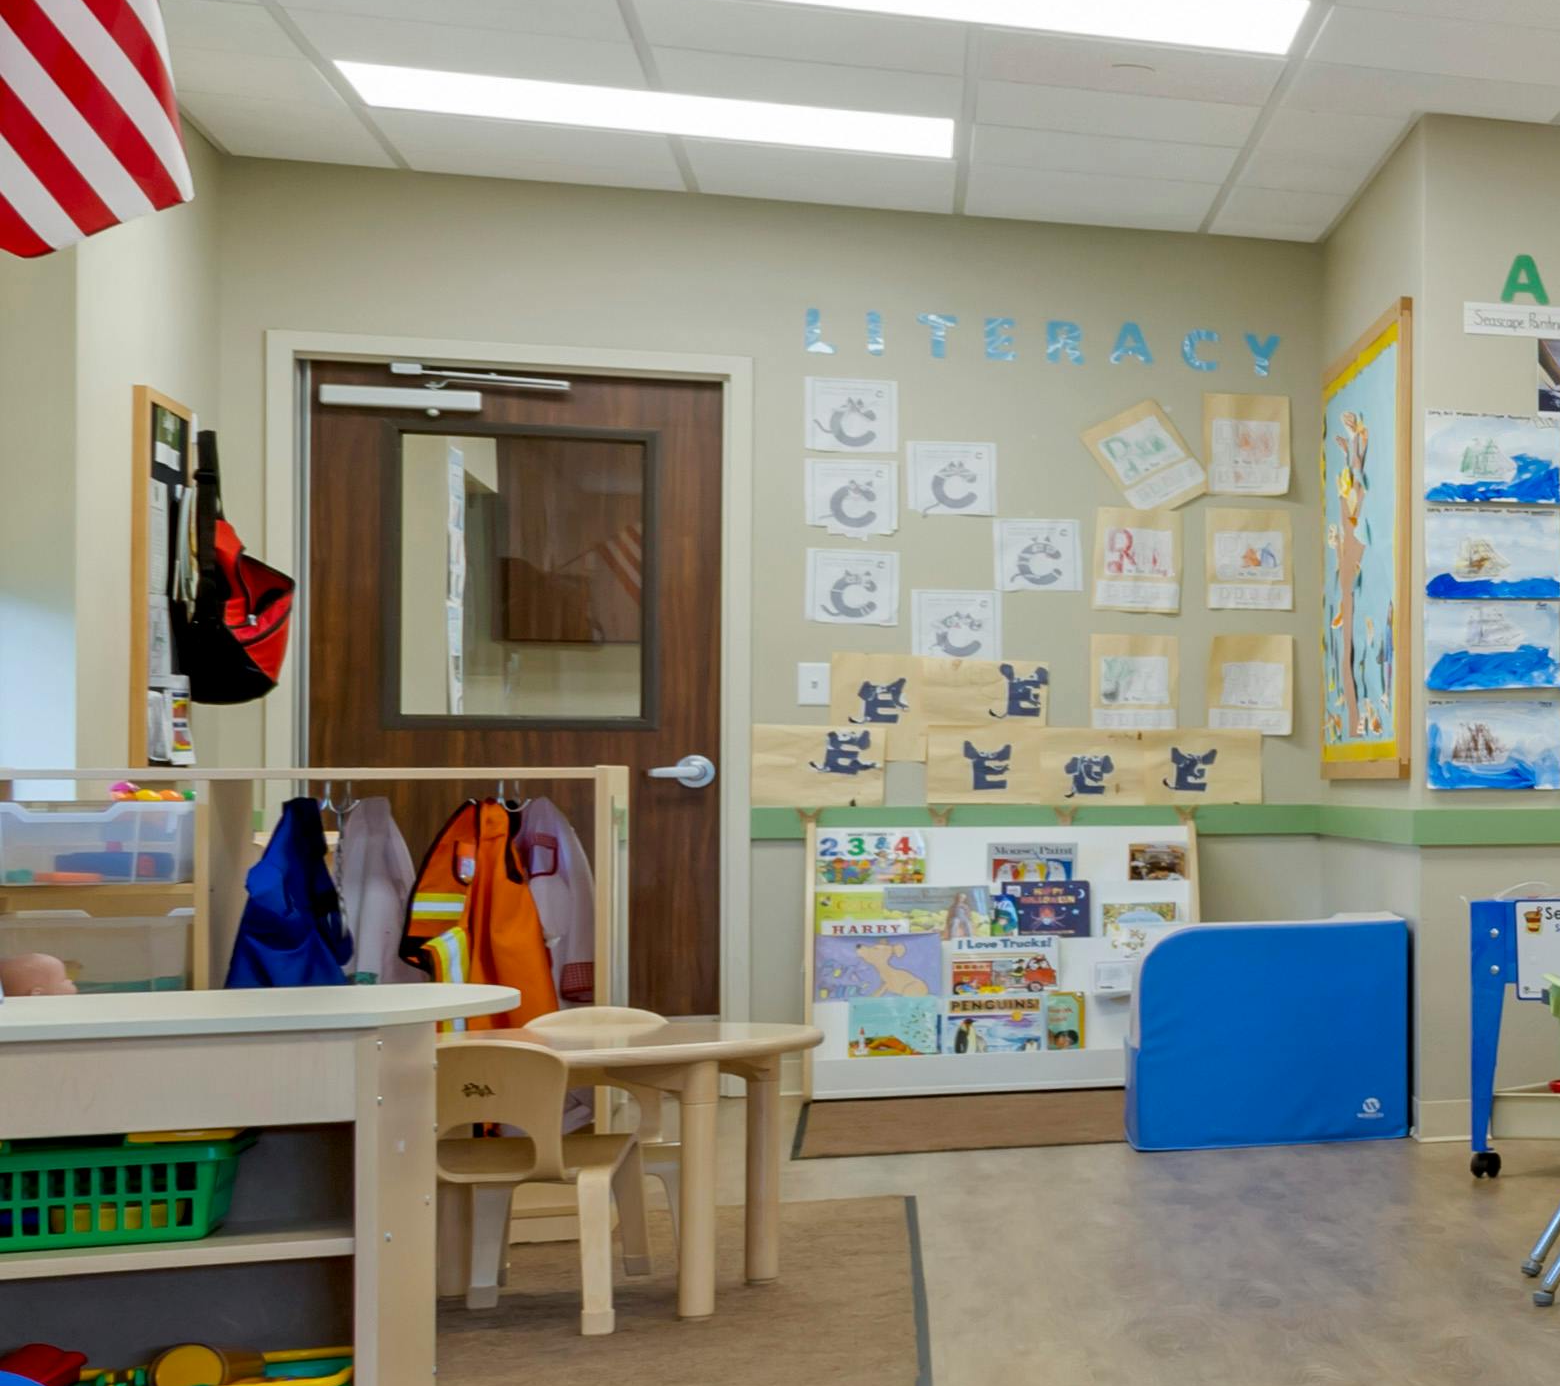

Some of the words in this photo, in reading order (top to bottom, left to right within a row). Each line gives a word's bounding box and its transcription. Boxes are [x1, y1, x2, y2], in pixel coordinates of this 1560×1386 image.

[1472, 308, 1527, 332] Seascape
[804, 308, 1282, 378] LITERACY
[994, 845, 1034, 857] Mouse
[1038, 845, 1074, 857] Paint
[831, 924, 902, 935] HARRY
[956, 939, 964, 950] I
[966, 939, 998, 950] Love
[1001, 936, 1053, 950] Trucks!
[950, 998, 1041, 1012] PENGUINS!
